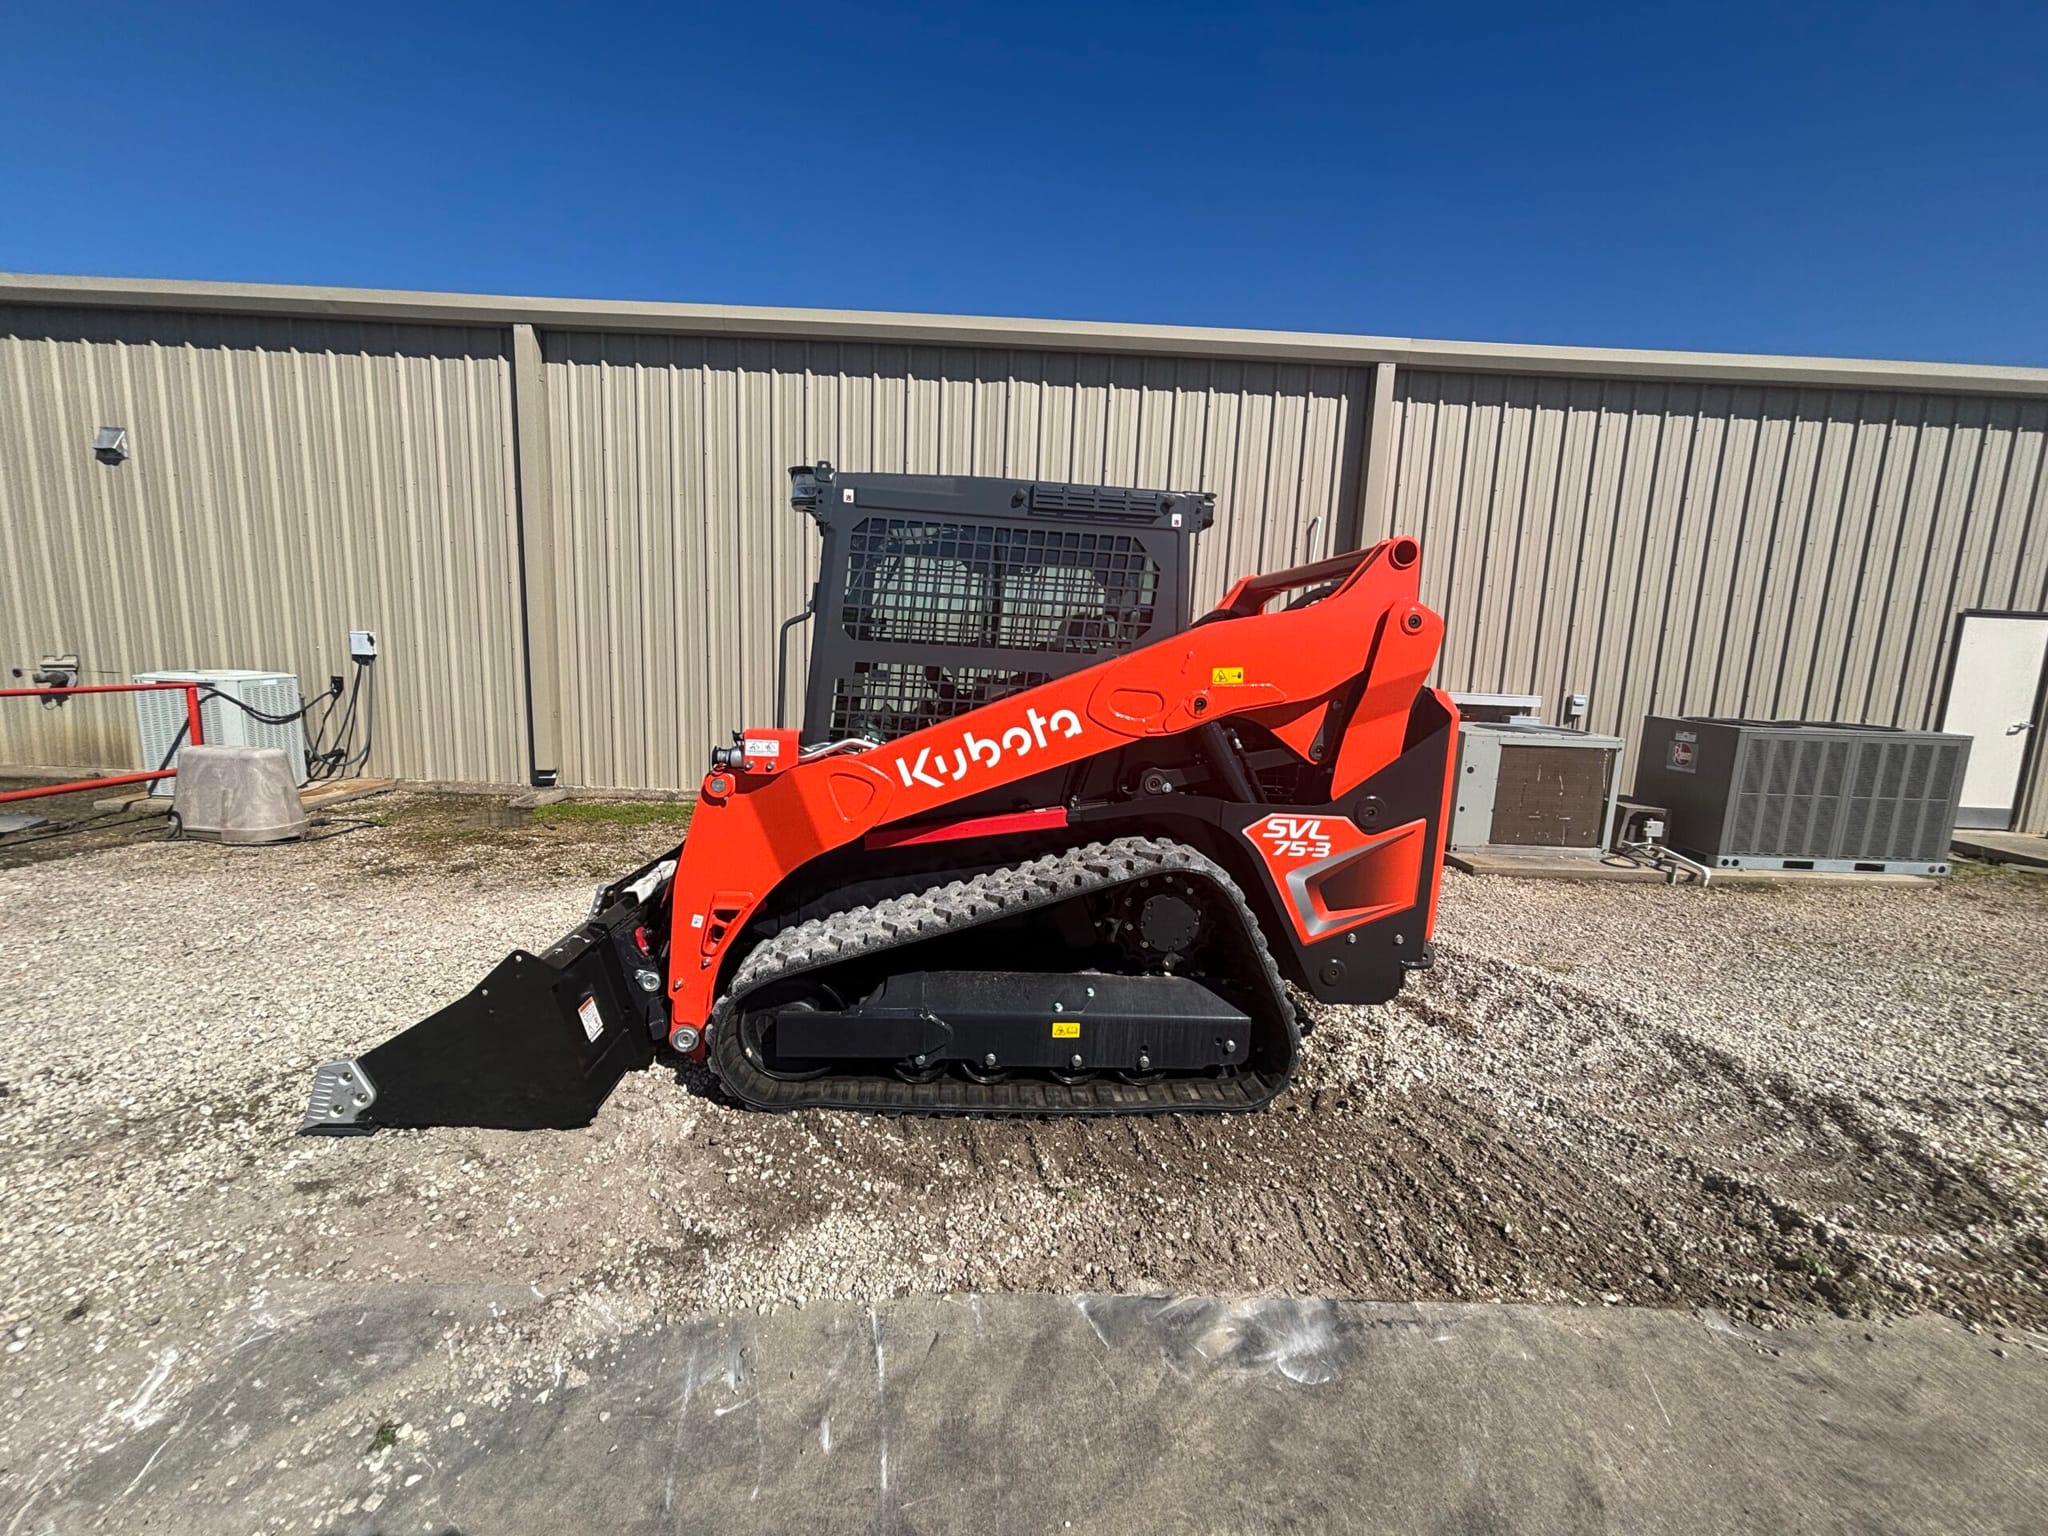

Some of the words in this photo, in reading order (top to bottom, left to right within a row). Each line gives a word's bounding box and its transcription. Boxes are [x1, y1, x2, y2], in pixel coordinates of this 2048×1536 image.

[895, 707, 1083, 789] Kubota
[1262, 818, 1330, 840] SVL
[1272, 840, 1332, 858] 75-3
